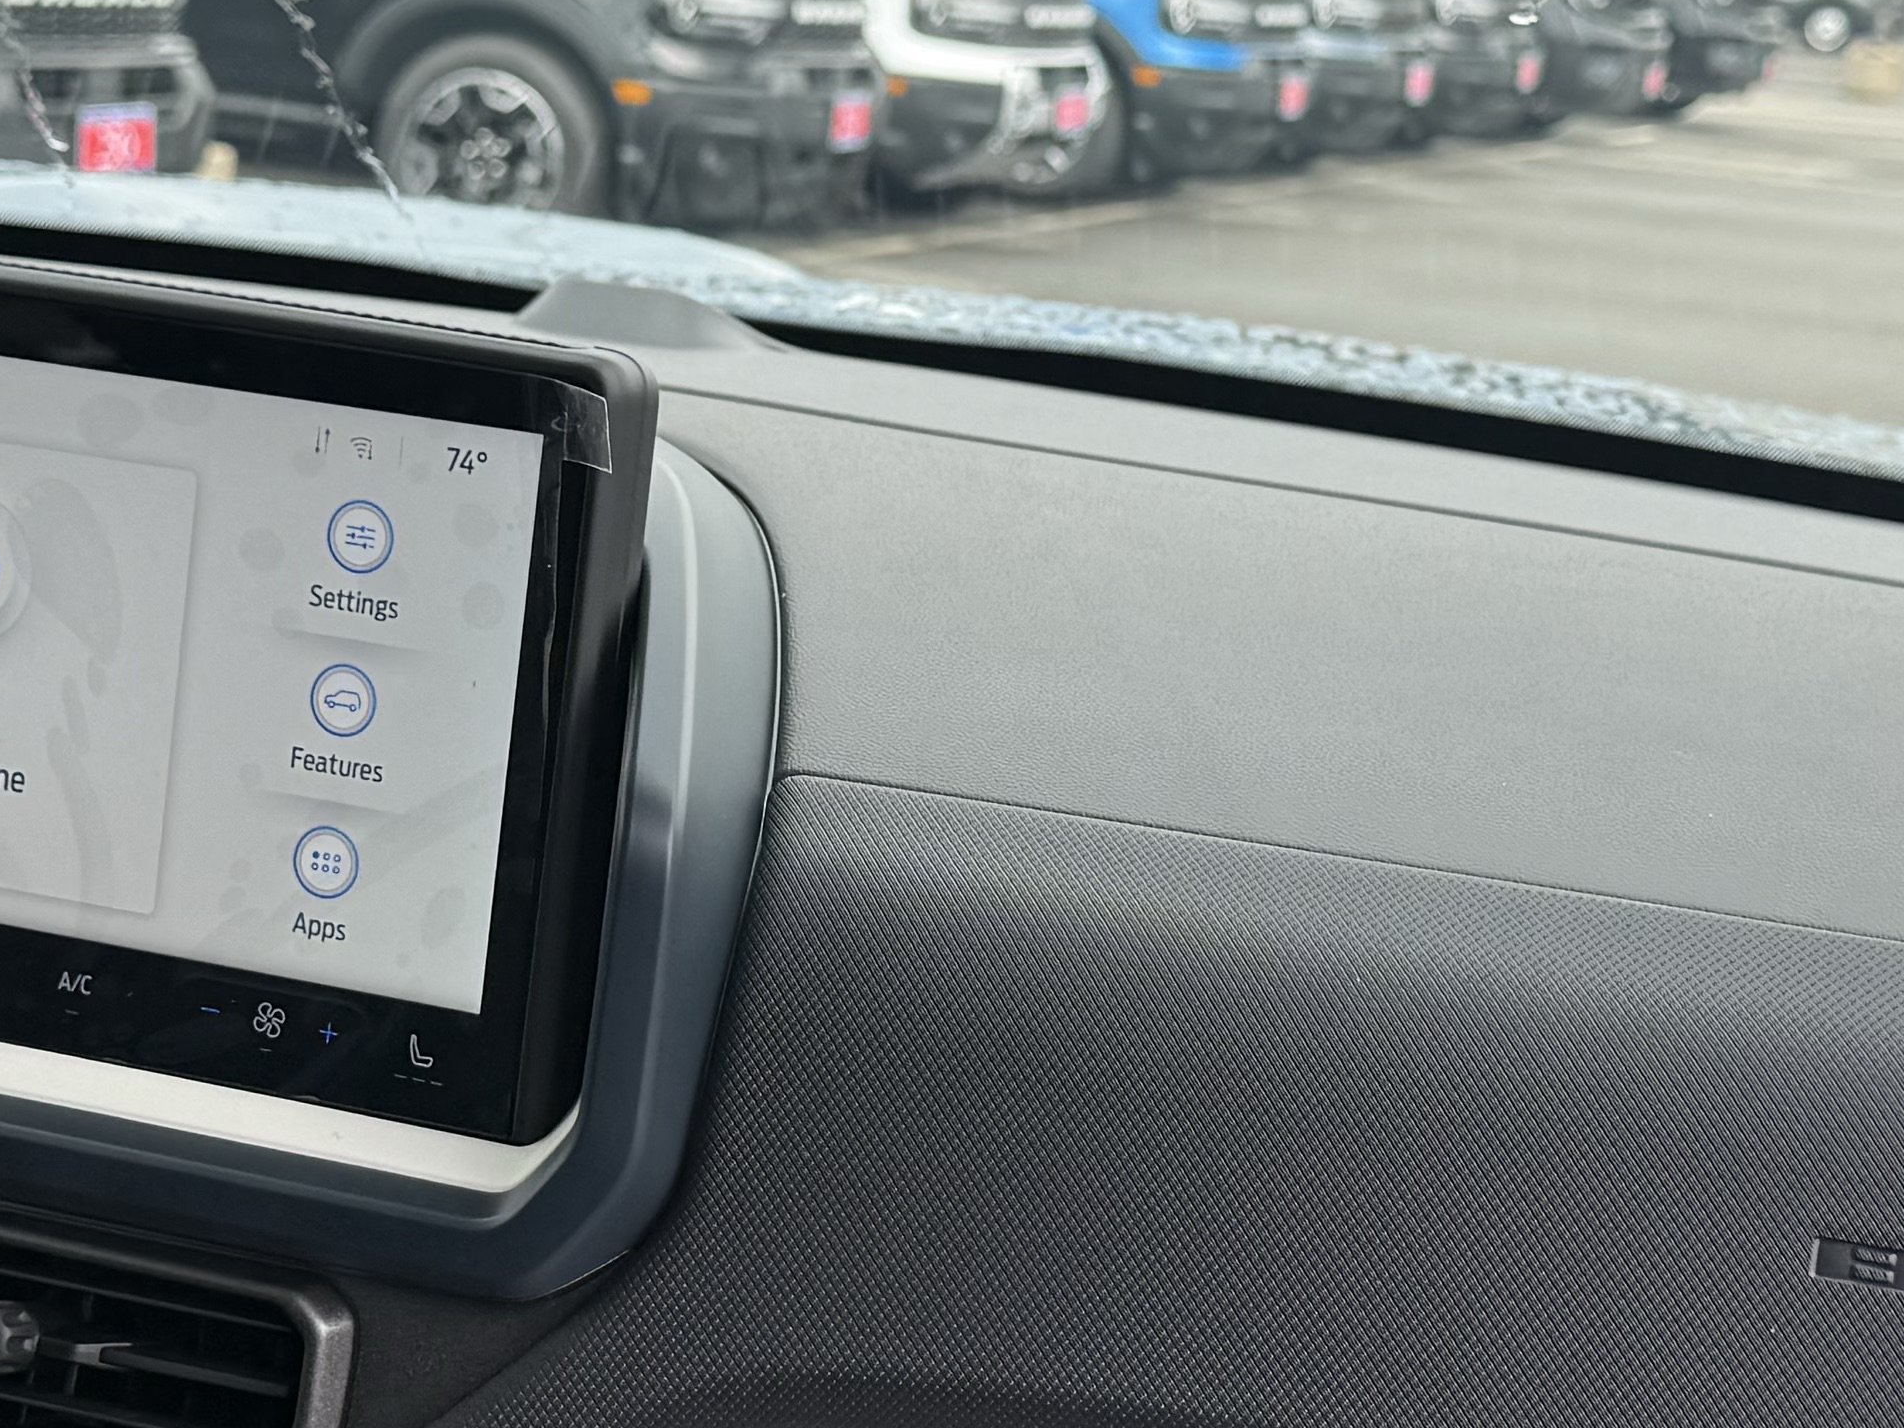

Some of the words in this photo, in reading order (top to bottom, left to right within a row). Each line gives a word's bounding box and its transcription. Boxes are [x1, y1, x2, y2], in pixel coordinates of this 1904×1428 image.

[309, 583, 399, 621] Settings
[290, 746, 384, 784] Features
[293, 911, 347, 943] Apps
[57, 972, 92, 996] A/C
